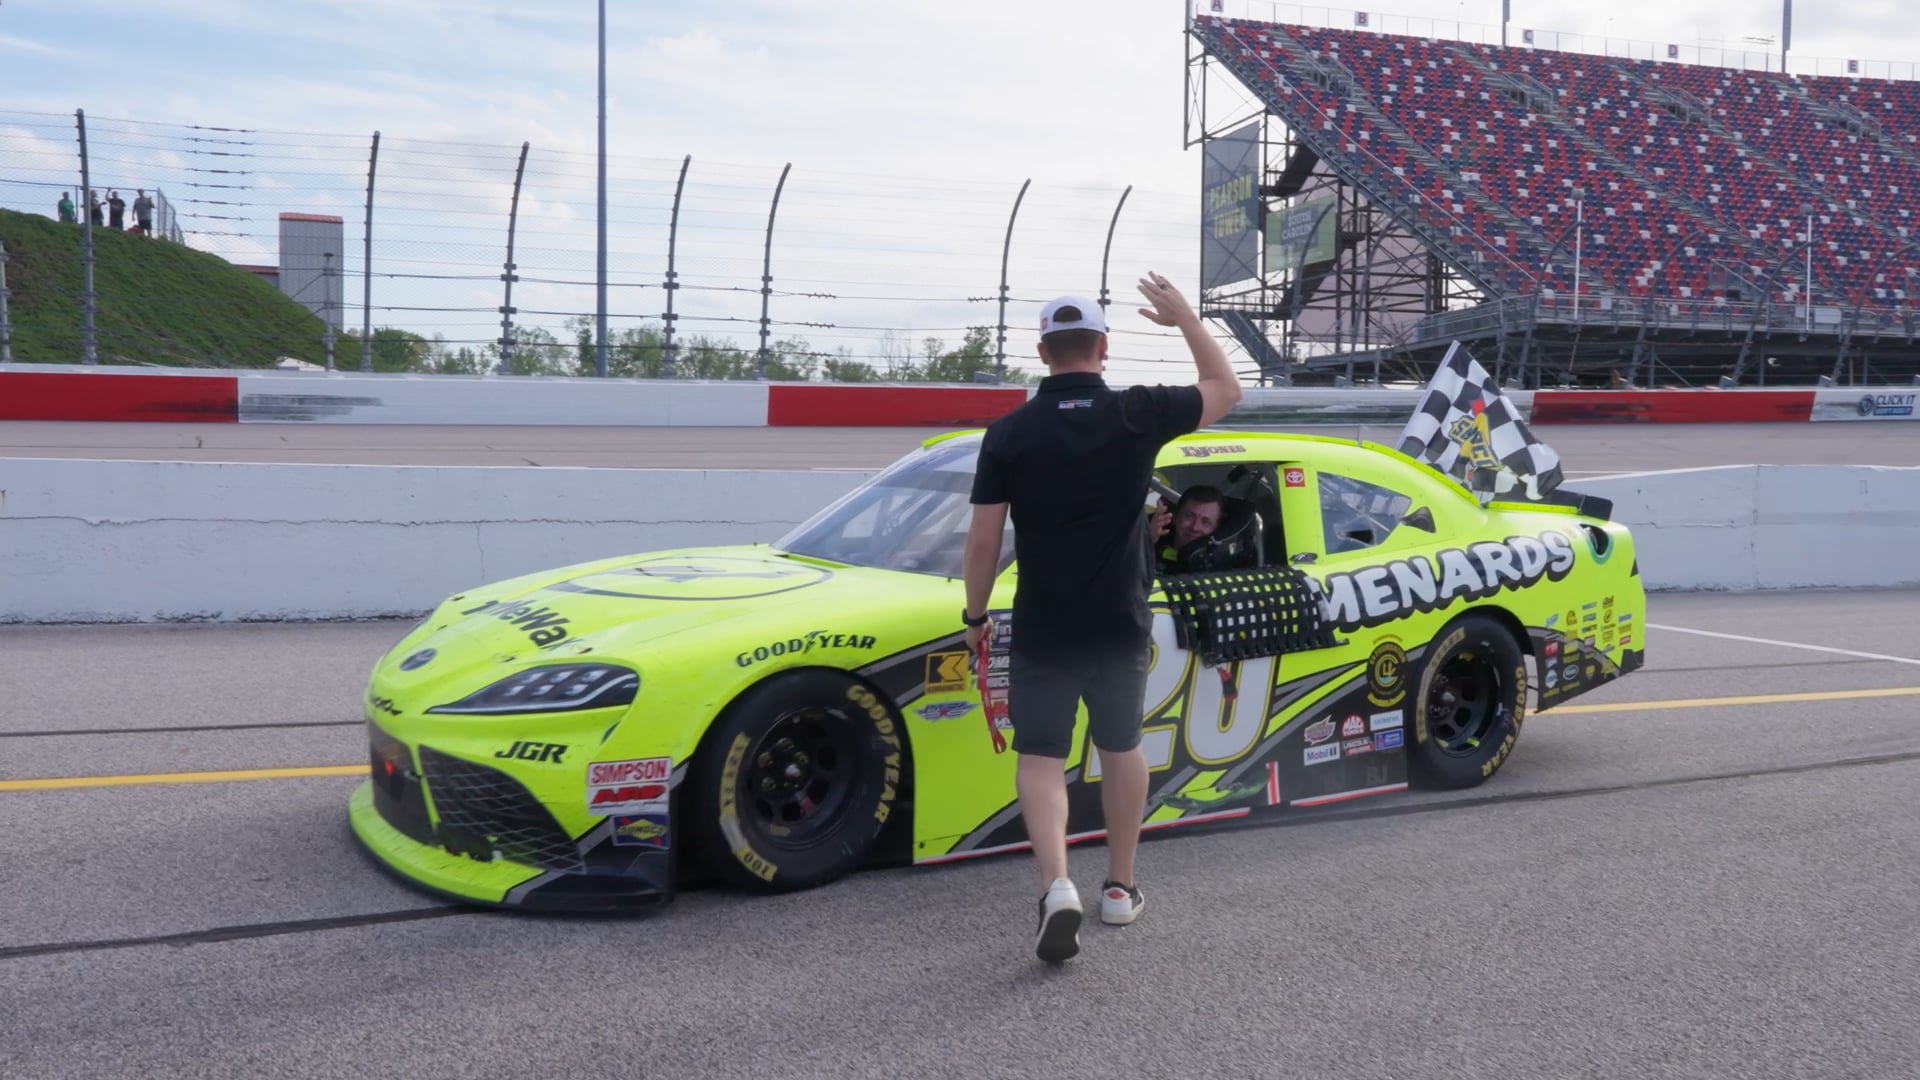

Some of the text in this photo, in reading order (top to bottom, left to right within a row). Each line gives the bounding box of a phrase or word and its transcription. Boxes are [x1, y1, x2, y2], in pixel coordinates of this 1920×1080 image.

[1358, 12, 1367, 24] B
[1282, 221, 1317, 240] CAROLIN
[1306, 531, 1574, 624] MENARDS
[735, 631, 877, 667] GOODYEAR
[1084, 607, 1279, 783] 20
[494, 740, 569, 763] JGR
[1306, 749, 1328, 760] Mobil
[591, 759, 668, 784] SIMPSON
[591, 784, 667, 804] ARP
